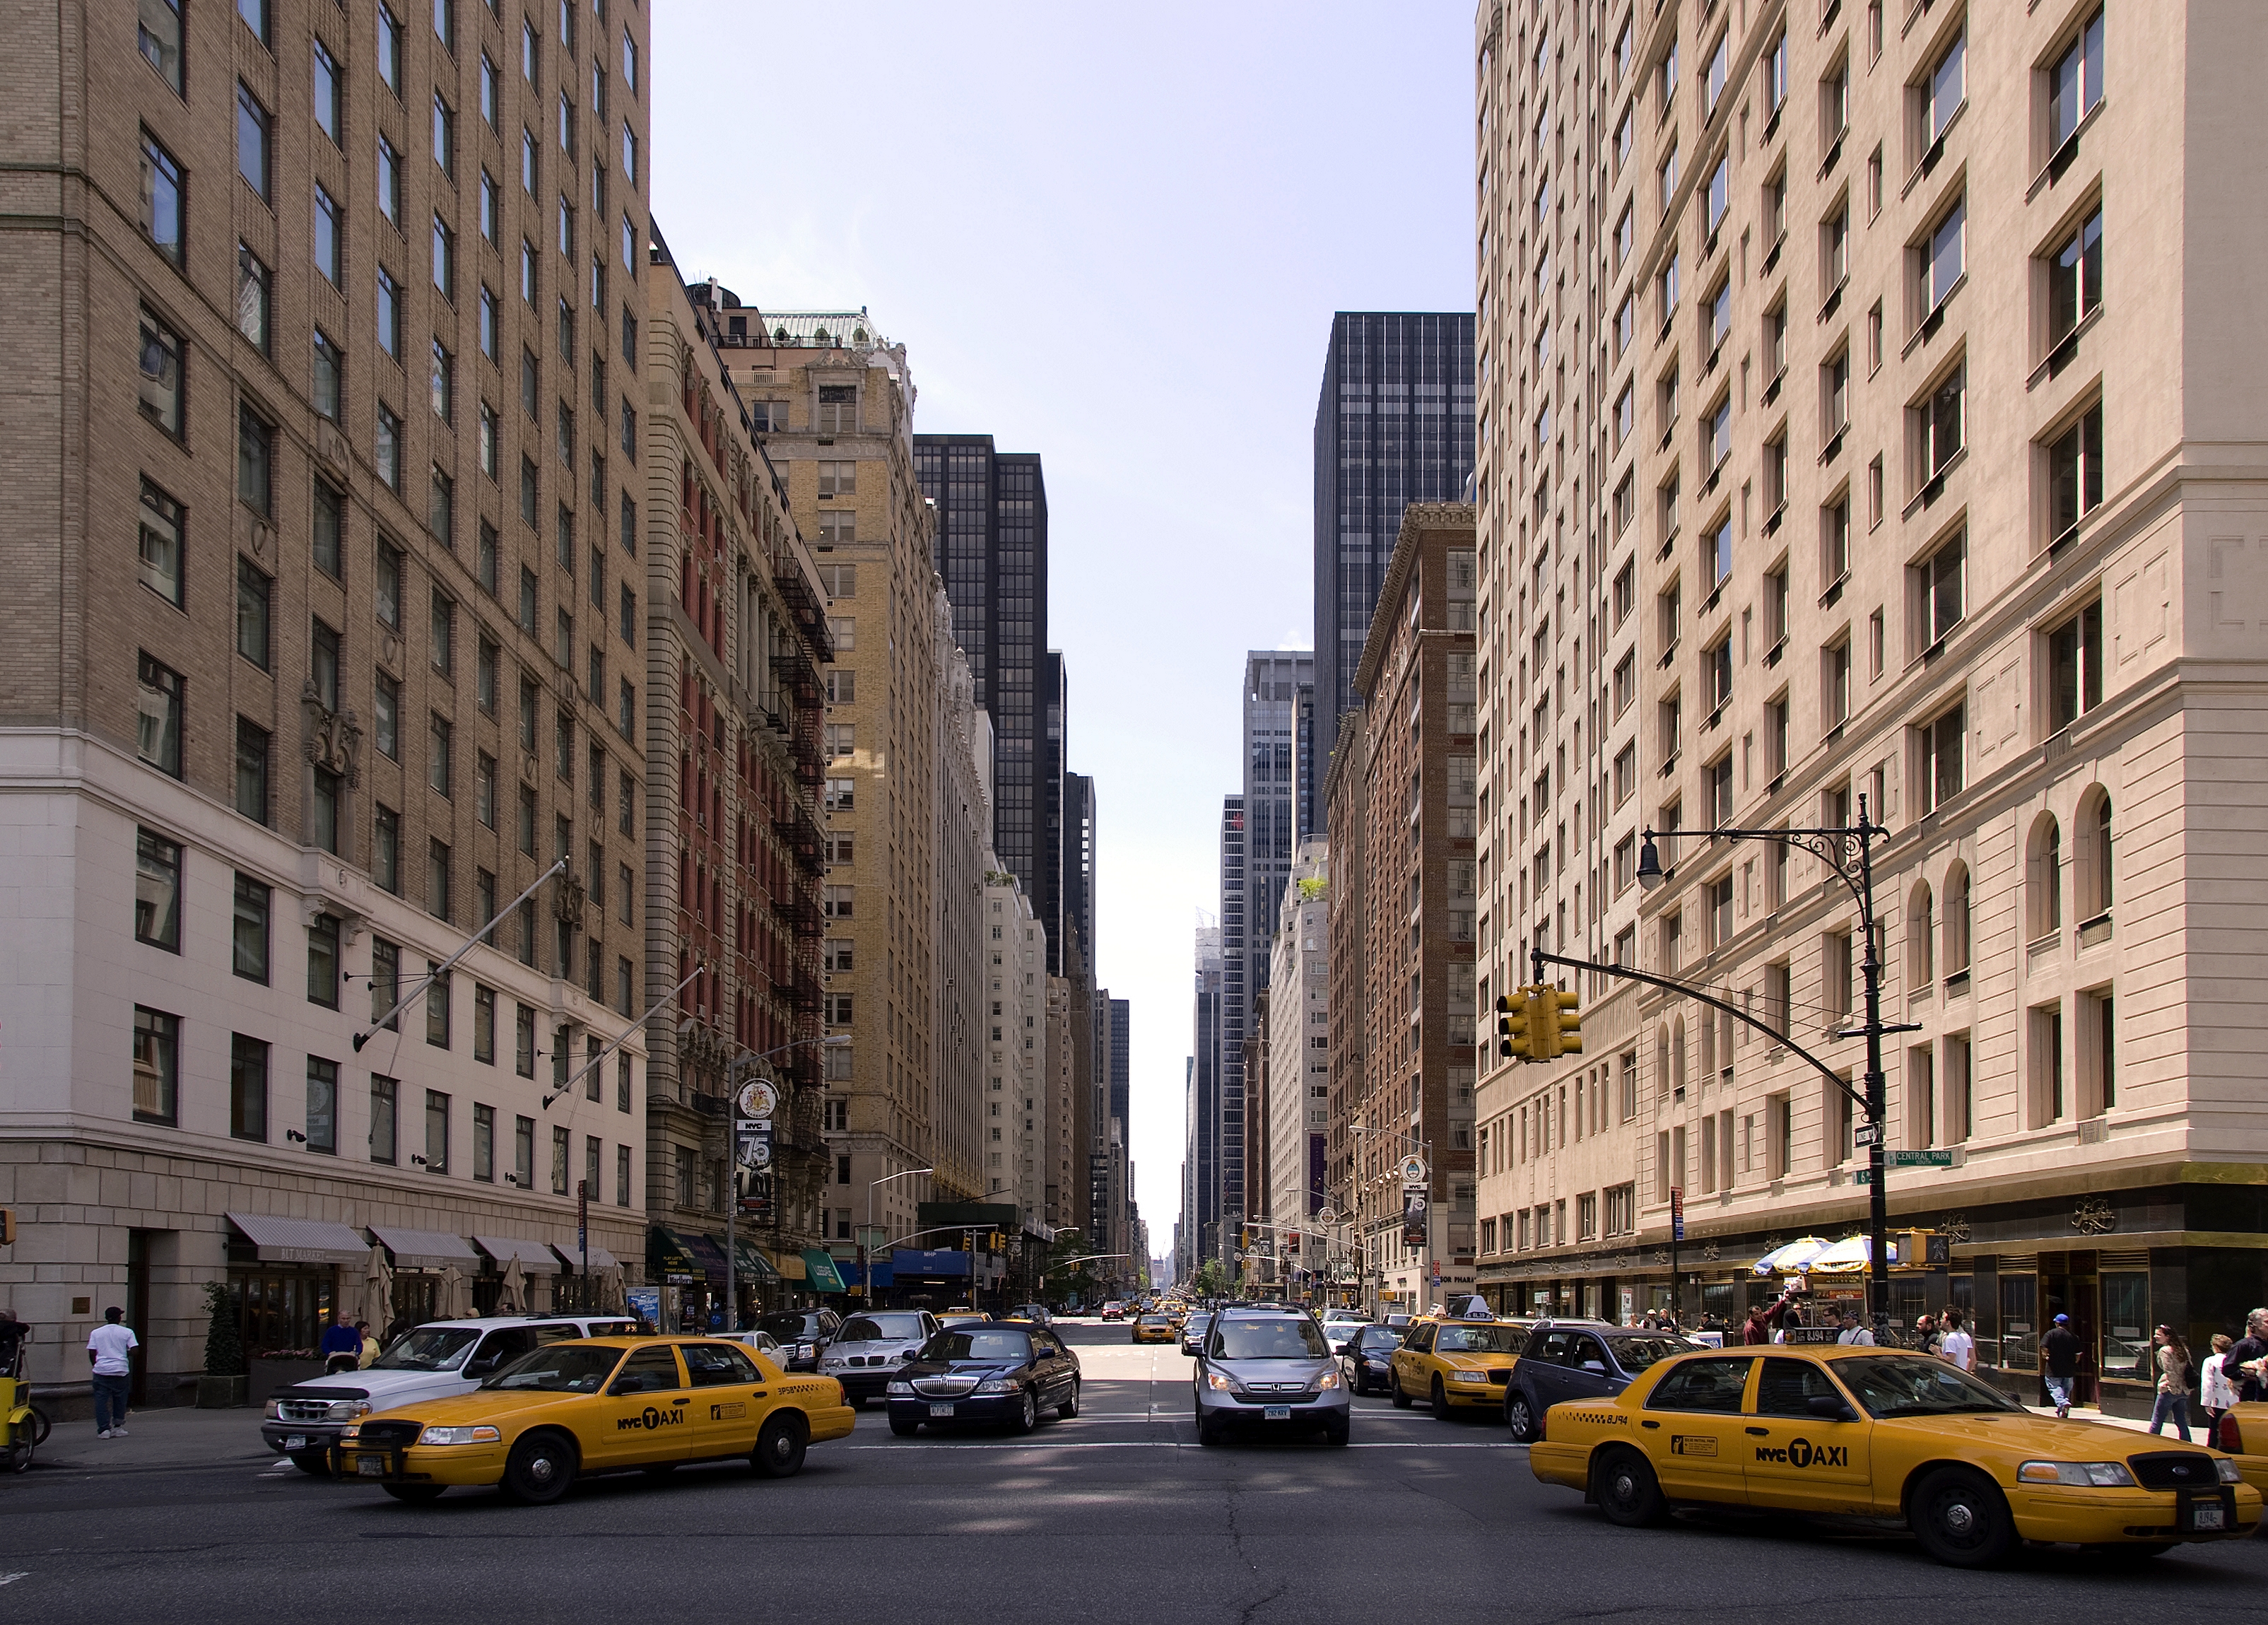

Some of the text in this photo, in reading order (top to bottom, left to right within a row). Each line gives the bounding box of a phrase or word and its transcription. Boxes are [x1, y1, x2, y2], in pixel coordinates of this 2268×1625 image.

[739, 1137, 770, 1164] 75
[1896, 1151, 1951, 1161] CENTRAL PARK
[1861, 1172, 1866, 1183] 6
[1404, 1194, 1426, 1212] 75
[281, 1248, 294, 1260] BLT
[295, 1249, 325, 1261] MARKET
[422, 1257, 444, 1267] MARKET
[1806, 1330, 1823, 1342] 8J94
[777, 1385, 794, 1395] 3P58
[617, 1408, 683, 1430] NYC TAXI
[1606, 1414, 1628, 1425] 8J94
[1756, 1440, 1847, 1467] NYC TAXI
